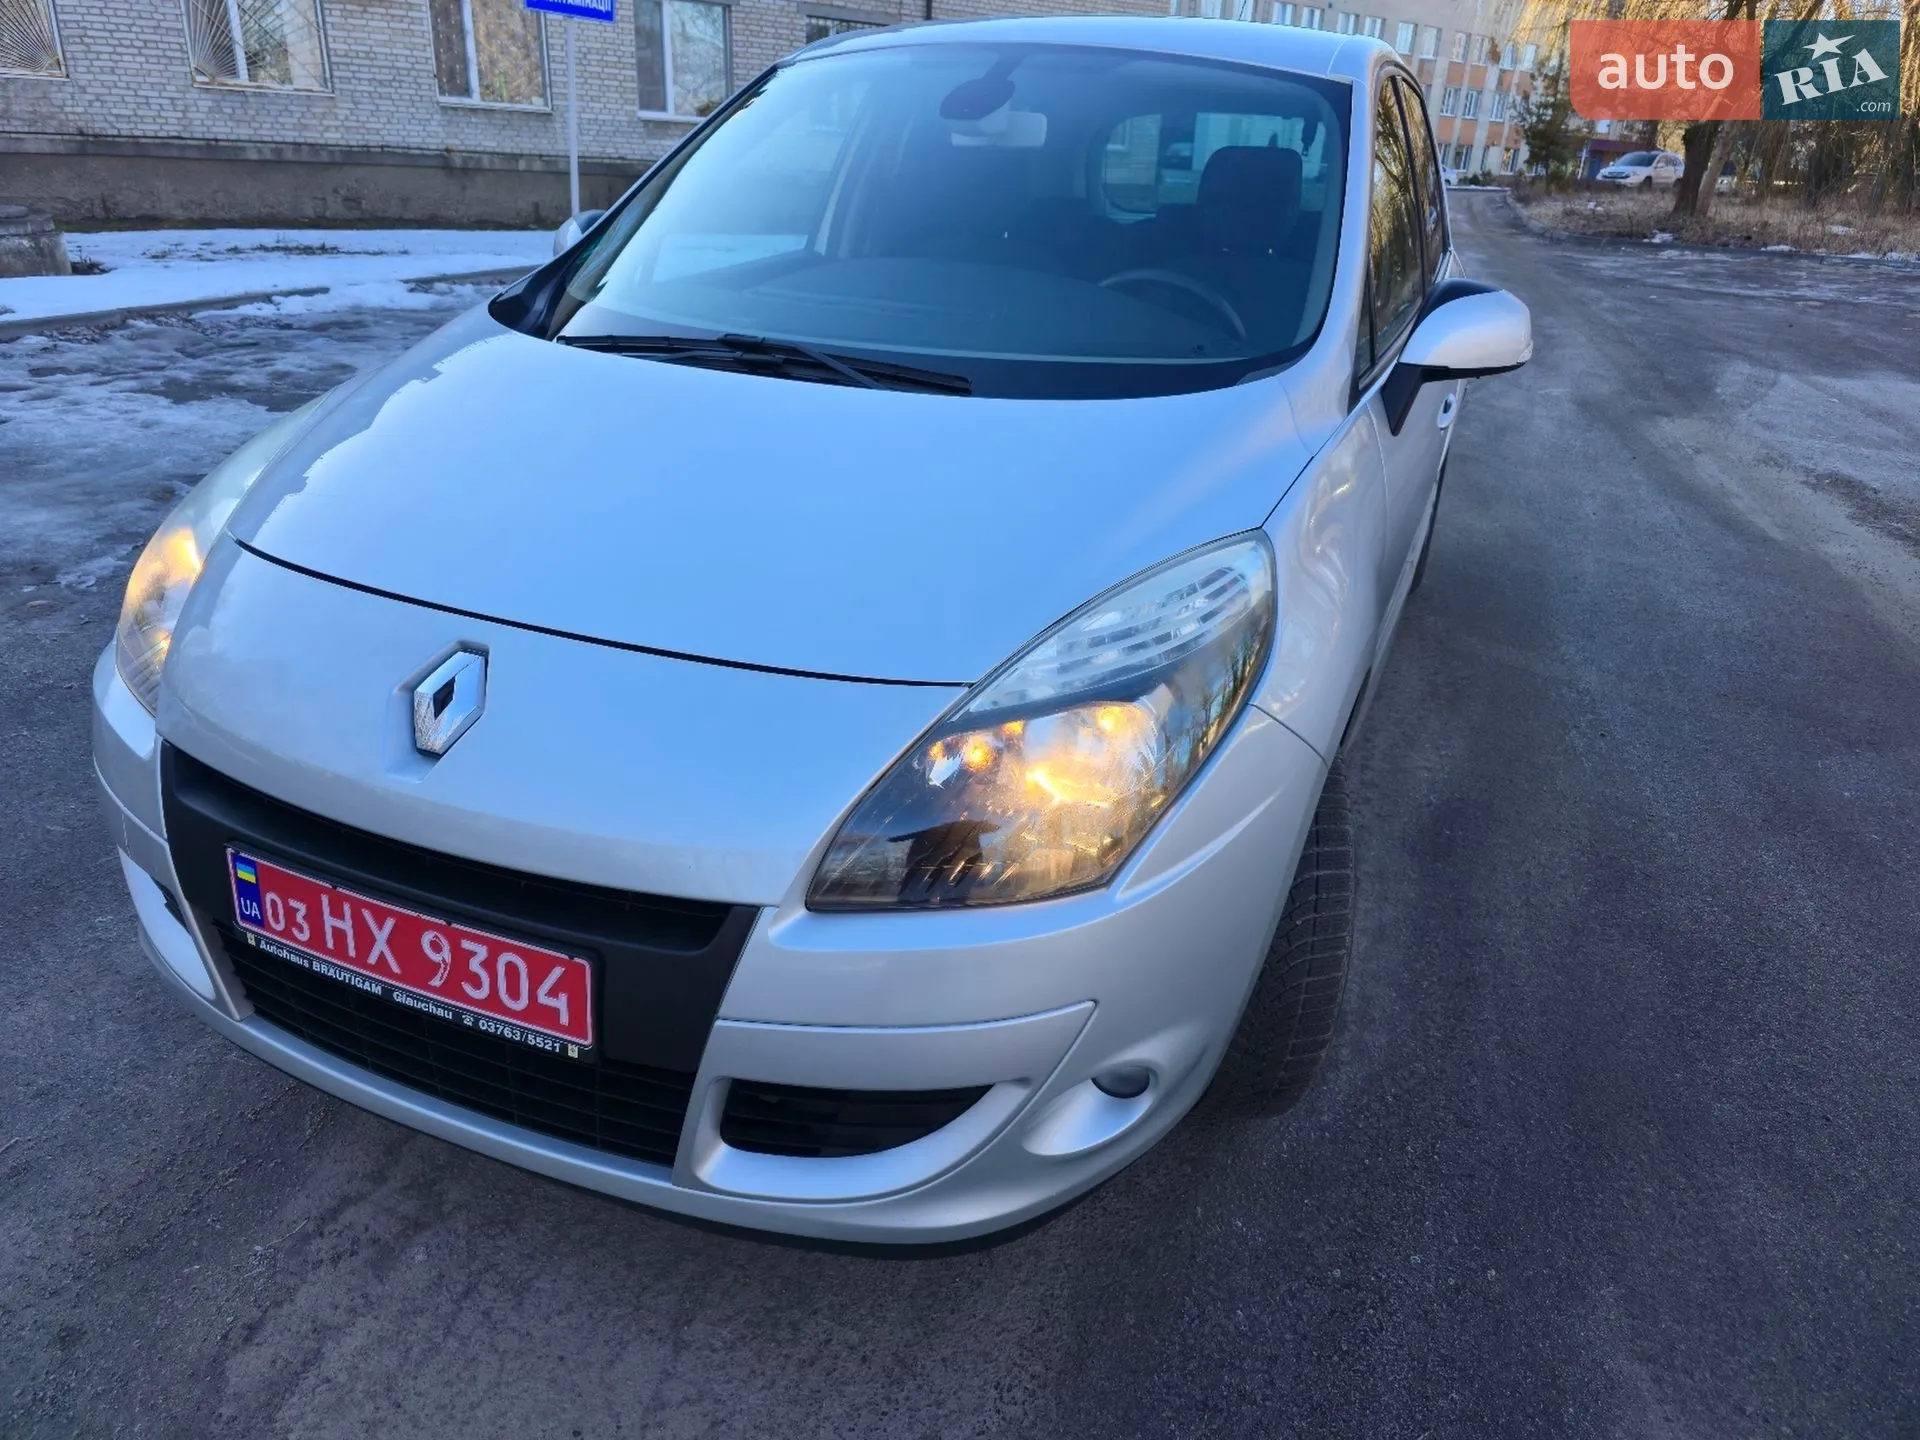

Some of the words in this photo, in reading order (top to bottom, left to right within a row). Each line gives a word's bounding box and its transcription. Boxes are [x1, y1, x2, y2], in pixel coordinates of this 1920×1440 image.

[240, 897, 261, 920] UA
[265, 891, 311, 942] 03
[320, 893, 402, 974] HX
[420, 930, 570, 1026] 9304
[259, 939, 310, 968] Autohaus
[393, 991, 453, 1020] Glauchau
[478, 1019, 561, 1053] 03763/5521
